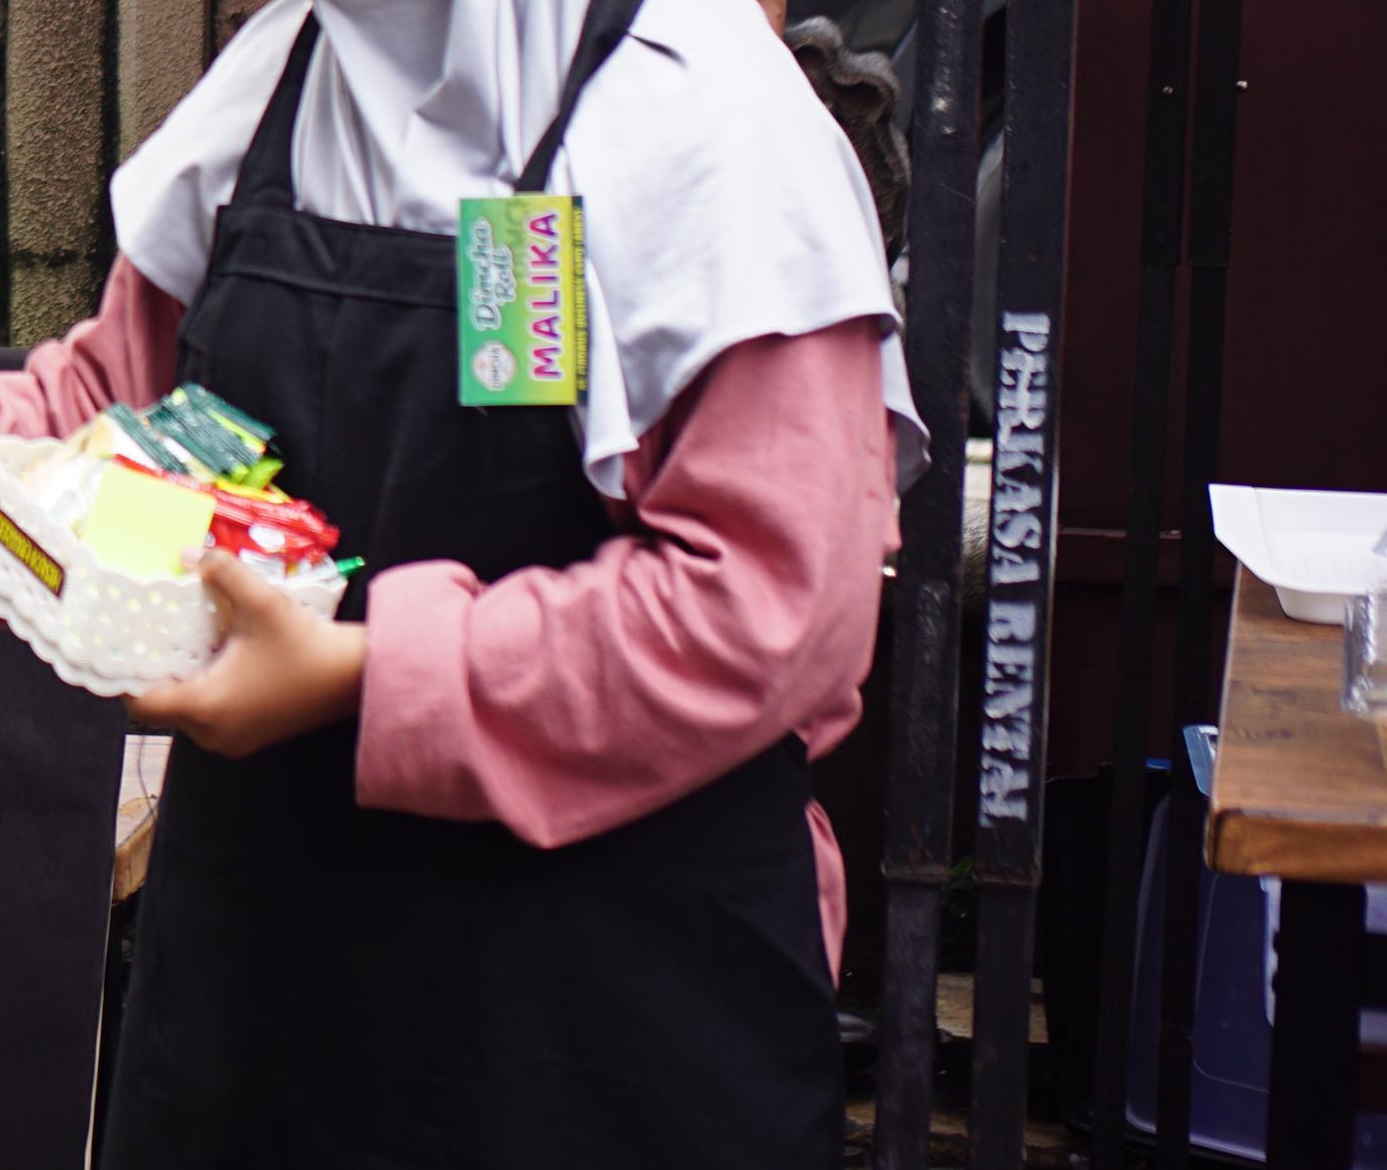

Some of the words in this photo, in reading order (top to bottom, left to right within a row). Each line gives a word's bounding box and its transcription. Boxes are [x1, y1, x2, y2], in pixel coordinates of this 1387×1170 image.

[473, 220, 494, 330] Dimcha
[494, 246, 514, 303] Roll
[530, 213, 562, 378] MALIKA
[991, 310, 1051, 587] PERKASA
[979, 603, 1037, 829] RENTAL
